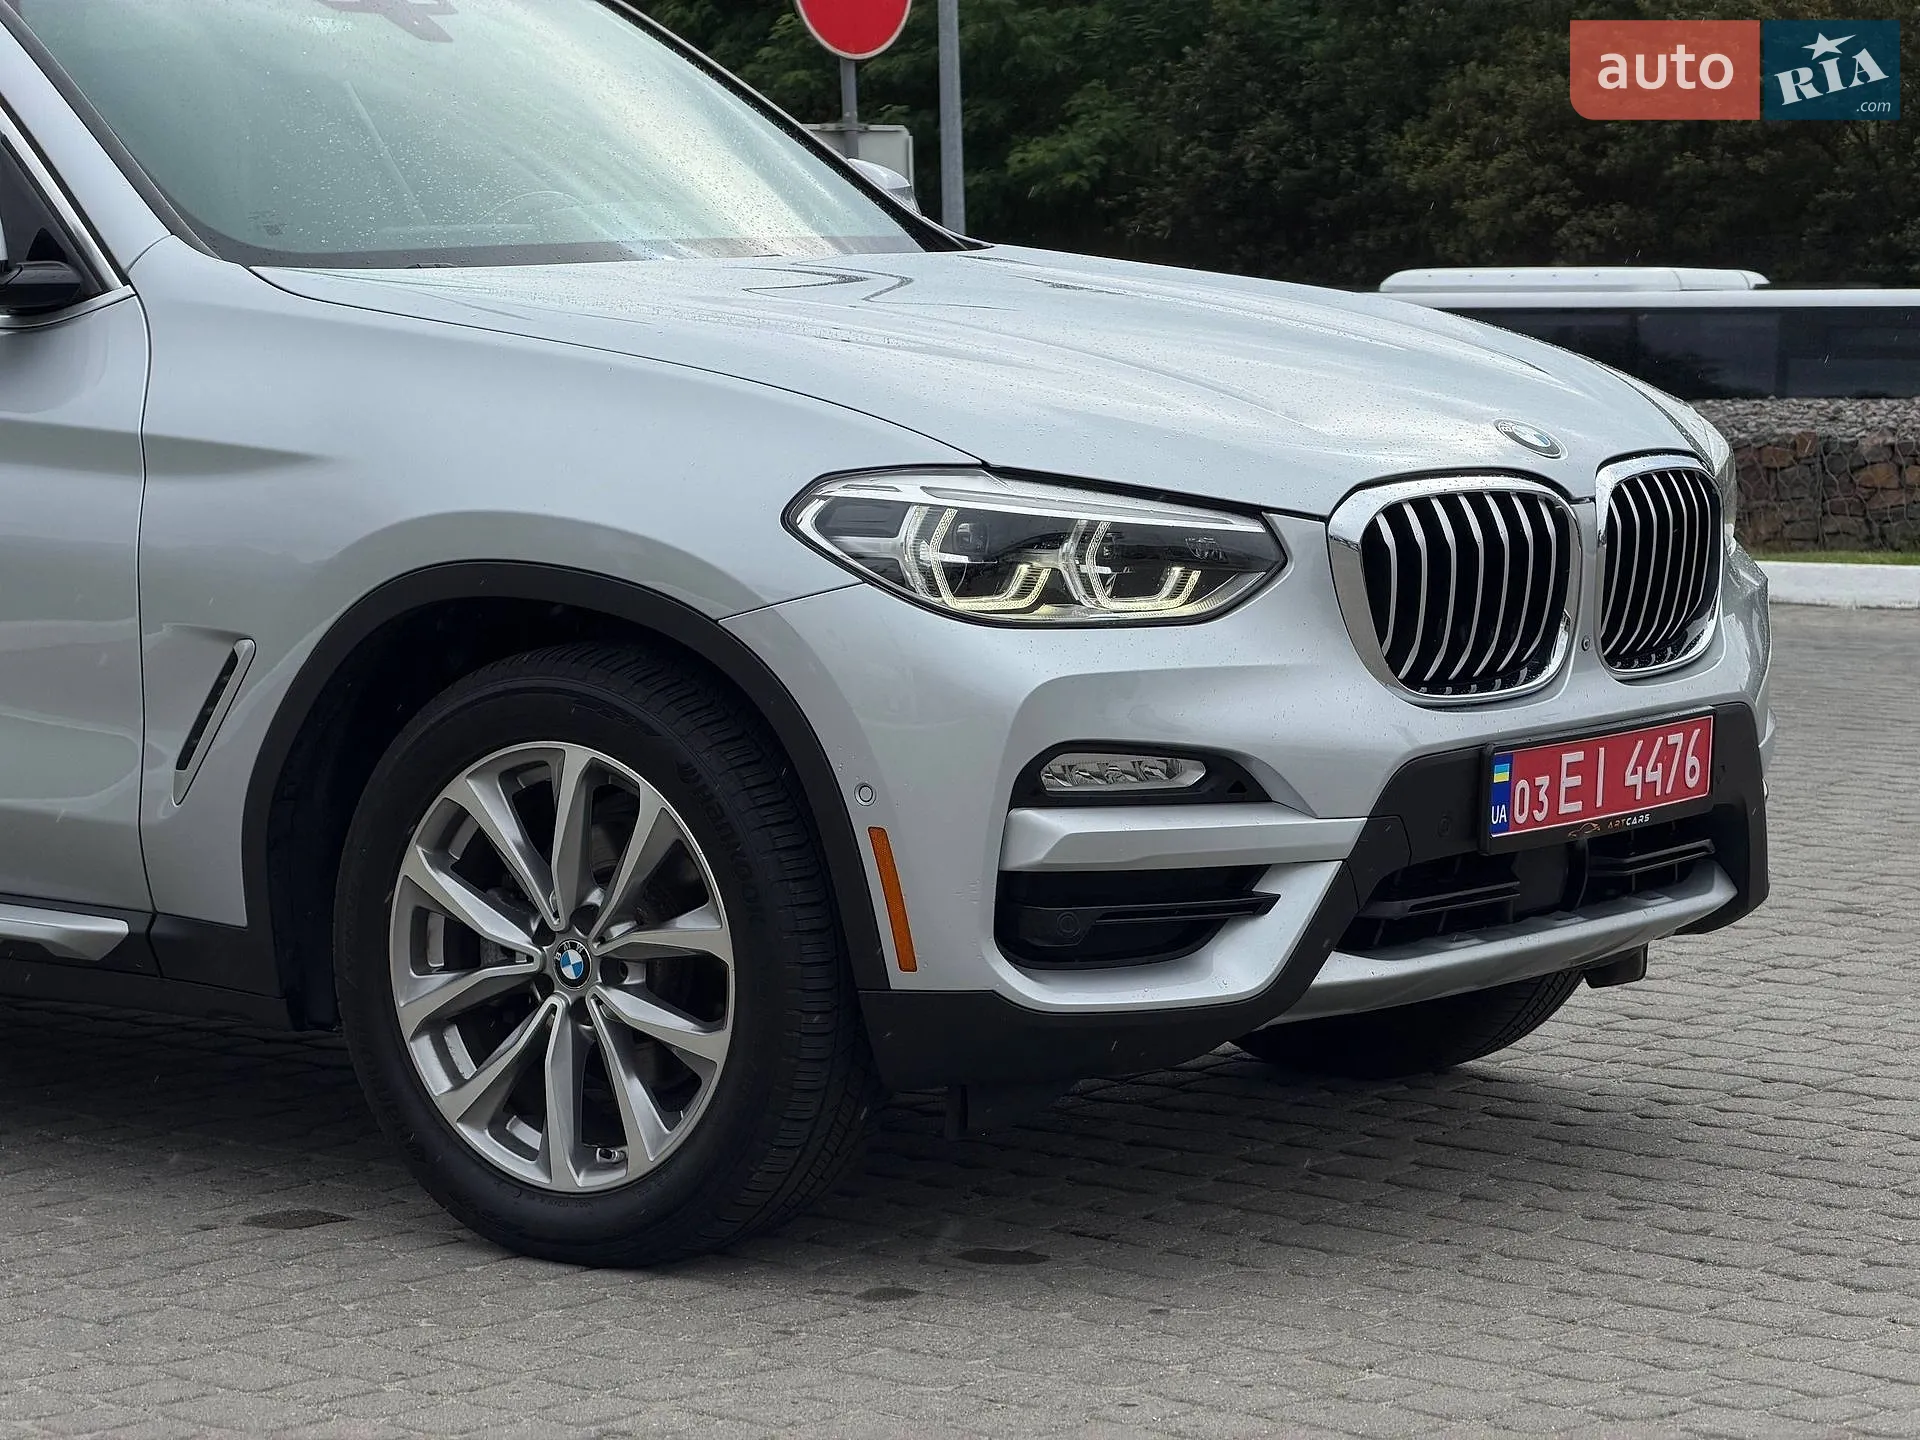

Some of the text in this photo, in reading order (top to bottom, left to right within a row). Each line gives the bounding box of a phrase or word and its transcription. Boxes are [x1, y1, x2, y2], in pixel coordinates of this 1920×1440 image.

[1624, 728, 1701, 801] 4476
[1491, 804, 1508, 825] UA
[554, 940, 585, 961] BMW
